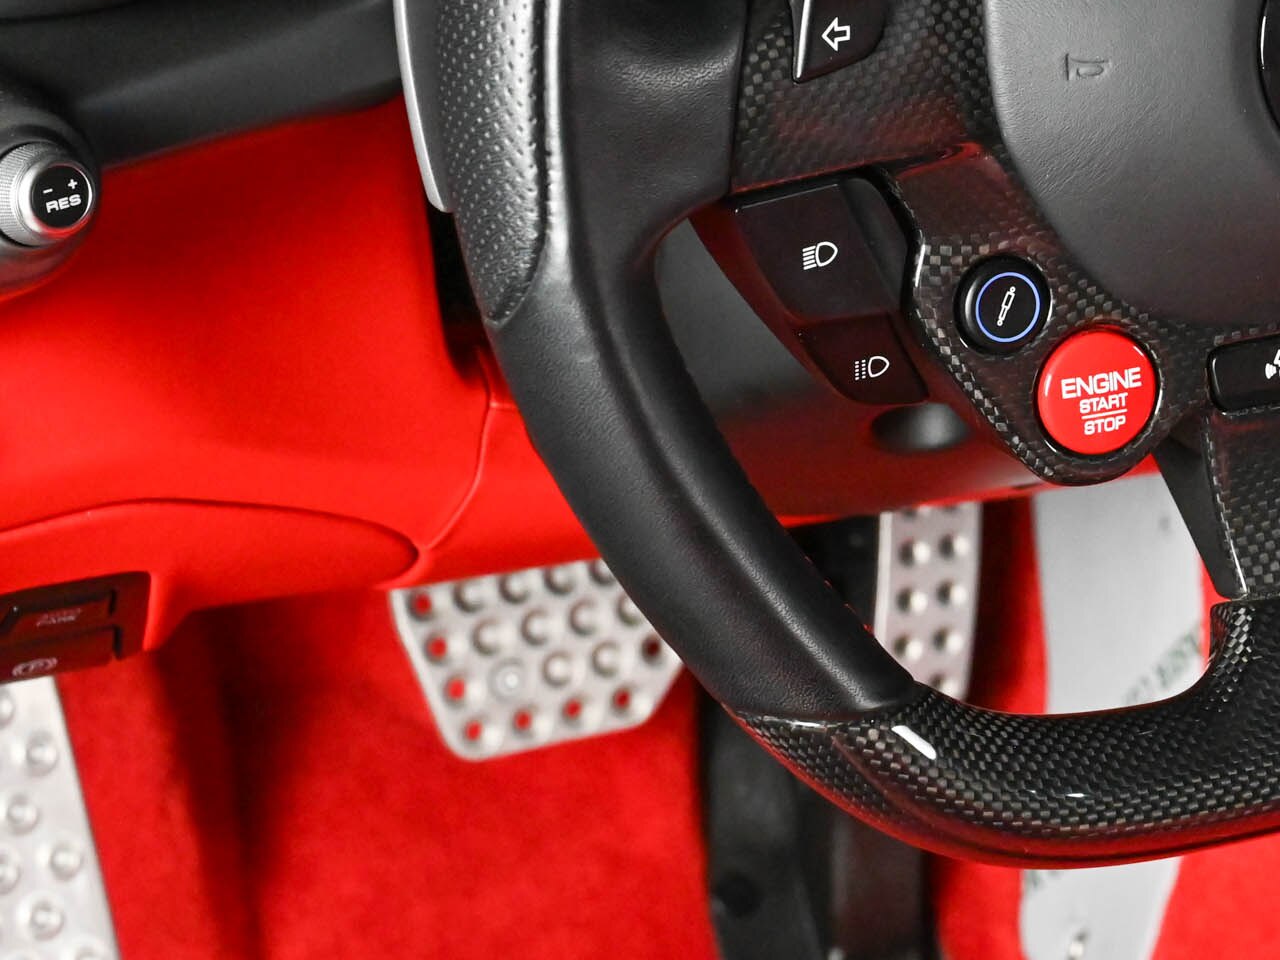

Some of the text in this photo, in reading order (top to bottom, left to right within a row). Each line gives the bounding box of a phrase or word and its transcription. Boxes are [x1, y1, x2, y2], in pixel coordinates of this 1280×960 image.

[46, 193, 82, 213] RES
[1061, 367, 1142, 400] ENGINE
[1079, 393, 1128, 414] START
[1084, 415, 1127, 436] STOP
